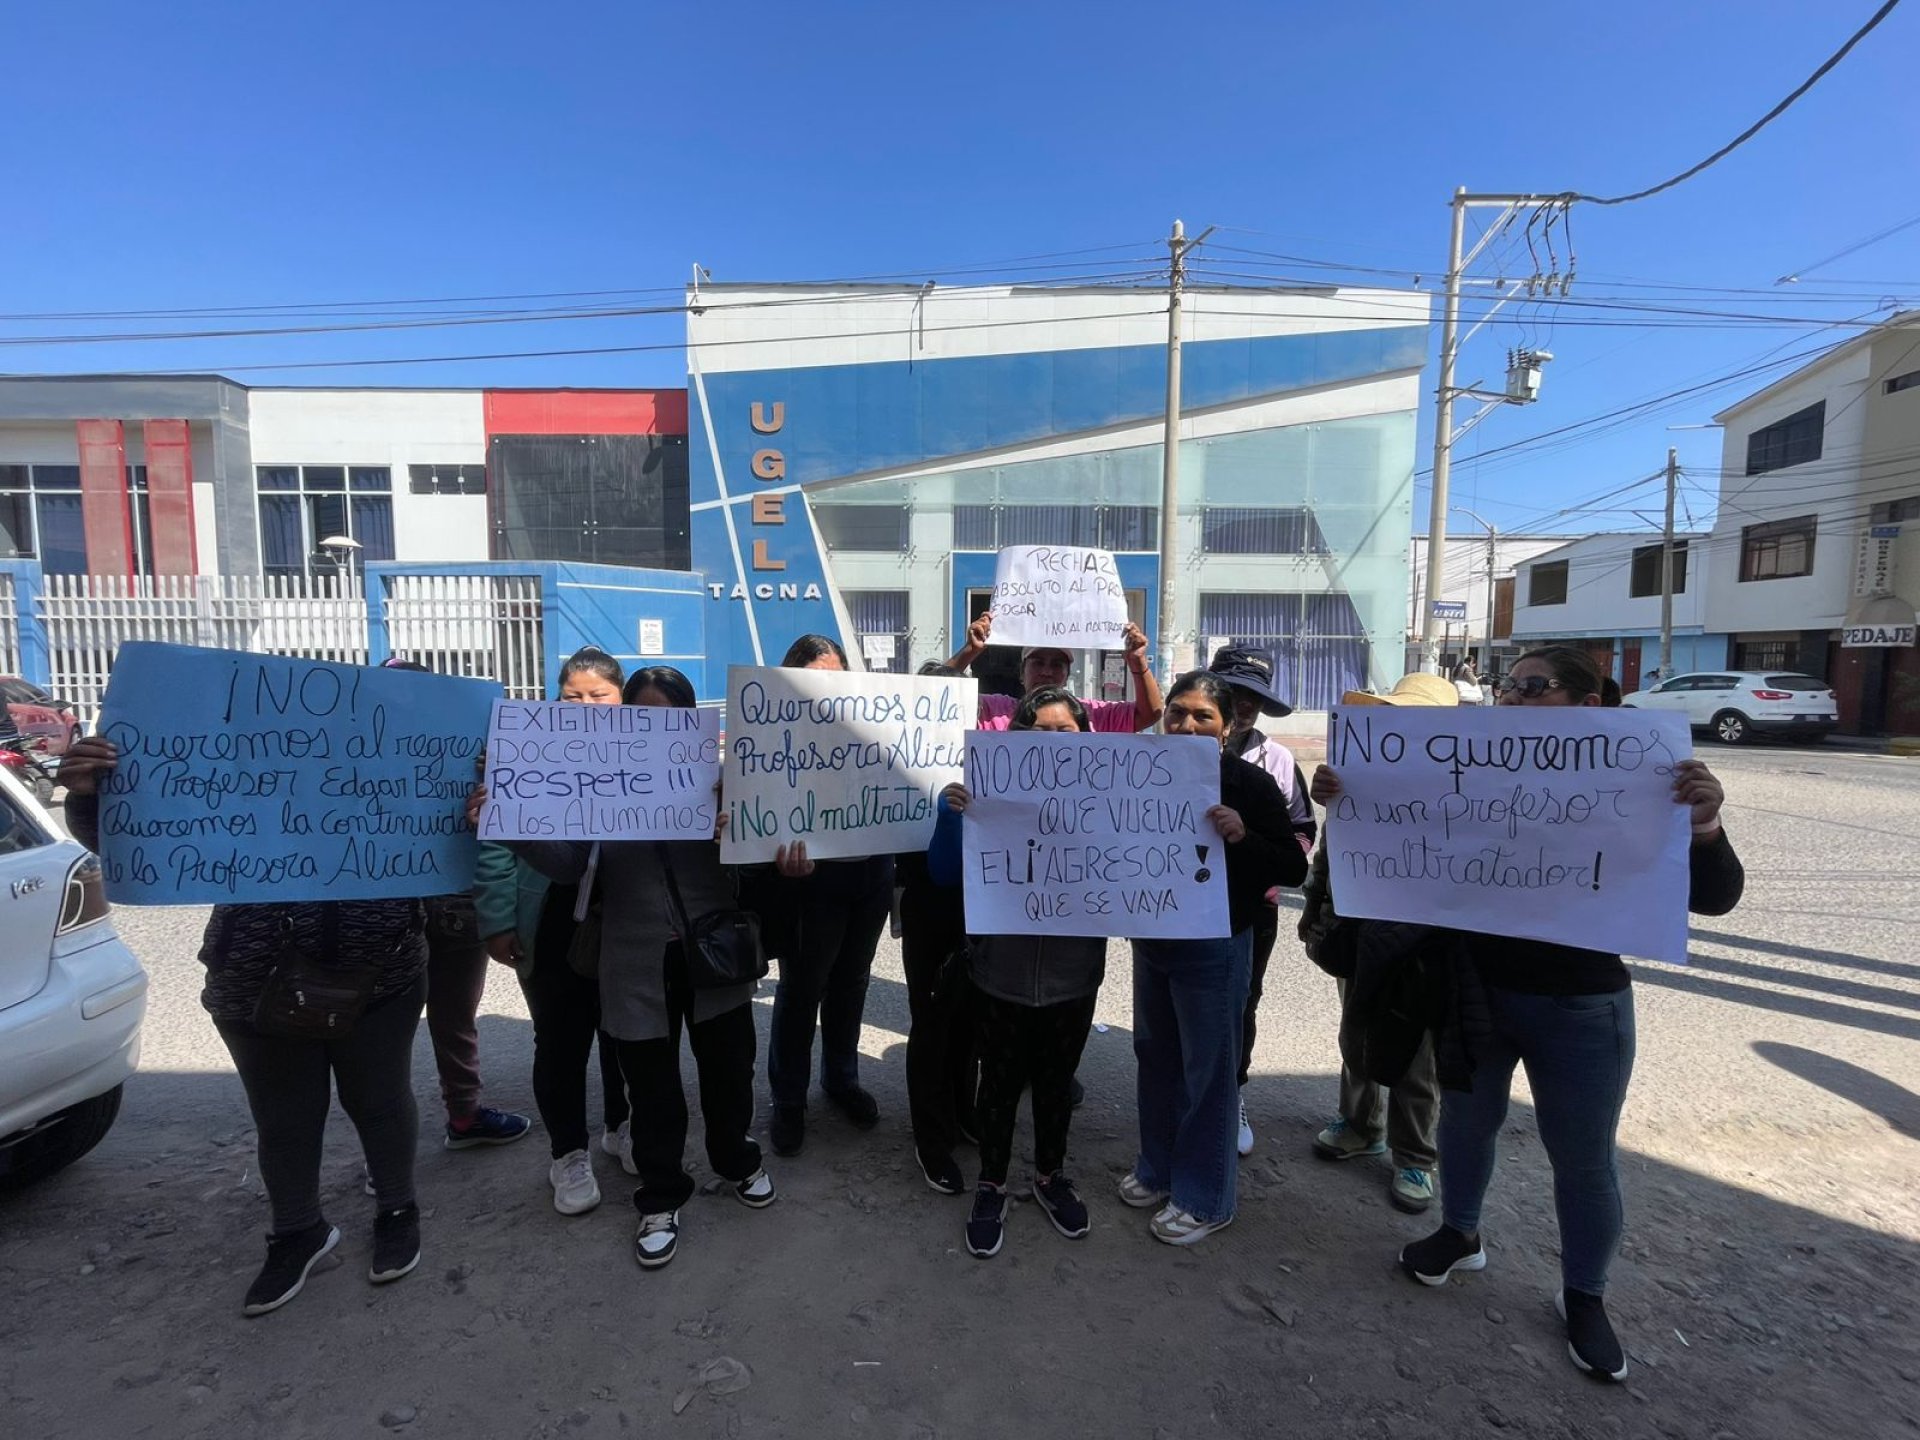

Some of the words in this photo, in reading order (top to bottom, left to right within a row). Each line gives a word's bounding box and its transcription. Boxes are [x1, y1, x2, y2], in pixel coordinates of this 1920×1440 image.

[751, 402, 786, 571] UGEL
[1026, 547, 1117, 575] RECHAZ
[708, 583, 822, 600] TACNA
[993, 580, 1062, 598] ABSOLUTO
[1068, 577, 1087, 592] AL
[1094, 576, 1124, 597] PRO
[224, 661, 362, 723] ¡NO!
[740, 681, 906, 725] Queremos
[937, 684, 959, 722] la
[105, 721, 330, 761] Queremos
[347, 704, 383, 759] al
[396, 733, 483, 780] regres
[497, 705, 651, 734] EXIGIMOS
[664, 709, 700, 731] UN
[733, 728, 882, 788] Profesora
[970, 745, 1013, 799] NO
[1018, 745, 1172, 792] QUEREMOS
[1330, 712, 1405, 767] ¡No
[1425, 729, 1682, 793] queremos
[150, 760, 298, 810] Profesor
[320, 766, 407, 816] Edgar
[731, 794, 778, 843] ¡No
[788, 790, 814, 833] al
[819, 782, 936, 832] maltrato!
[1373, 800, 1429, 825] un
[103, 801, 257, 838] Queremos
[280, 800, 313, 835] la
[484, 804, 504, 836] A
[1038, 796, 1097, 835] QUE
[1106, 798, 1197, 834] VUELVA
[132, 847, 160, 885] la
[168, 845, 317, 893] Profesora
[324, 838, 440, 886] Alicia
[1342, 834, 1603, 890] maltratador!
[1024, 891, 1072, 921] QUE
[1083, 891, 1114, 915] SE
[1121, 888, 1179, 920] VAYA
